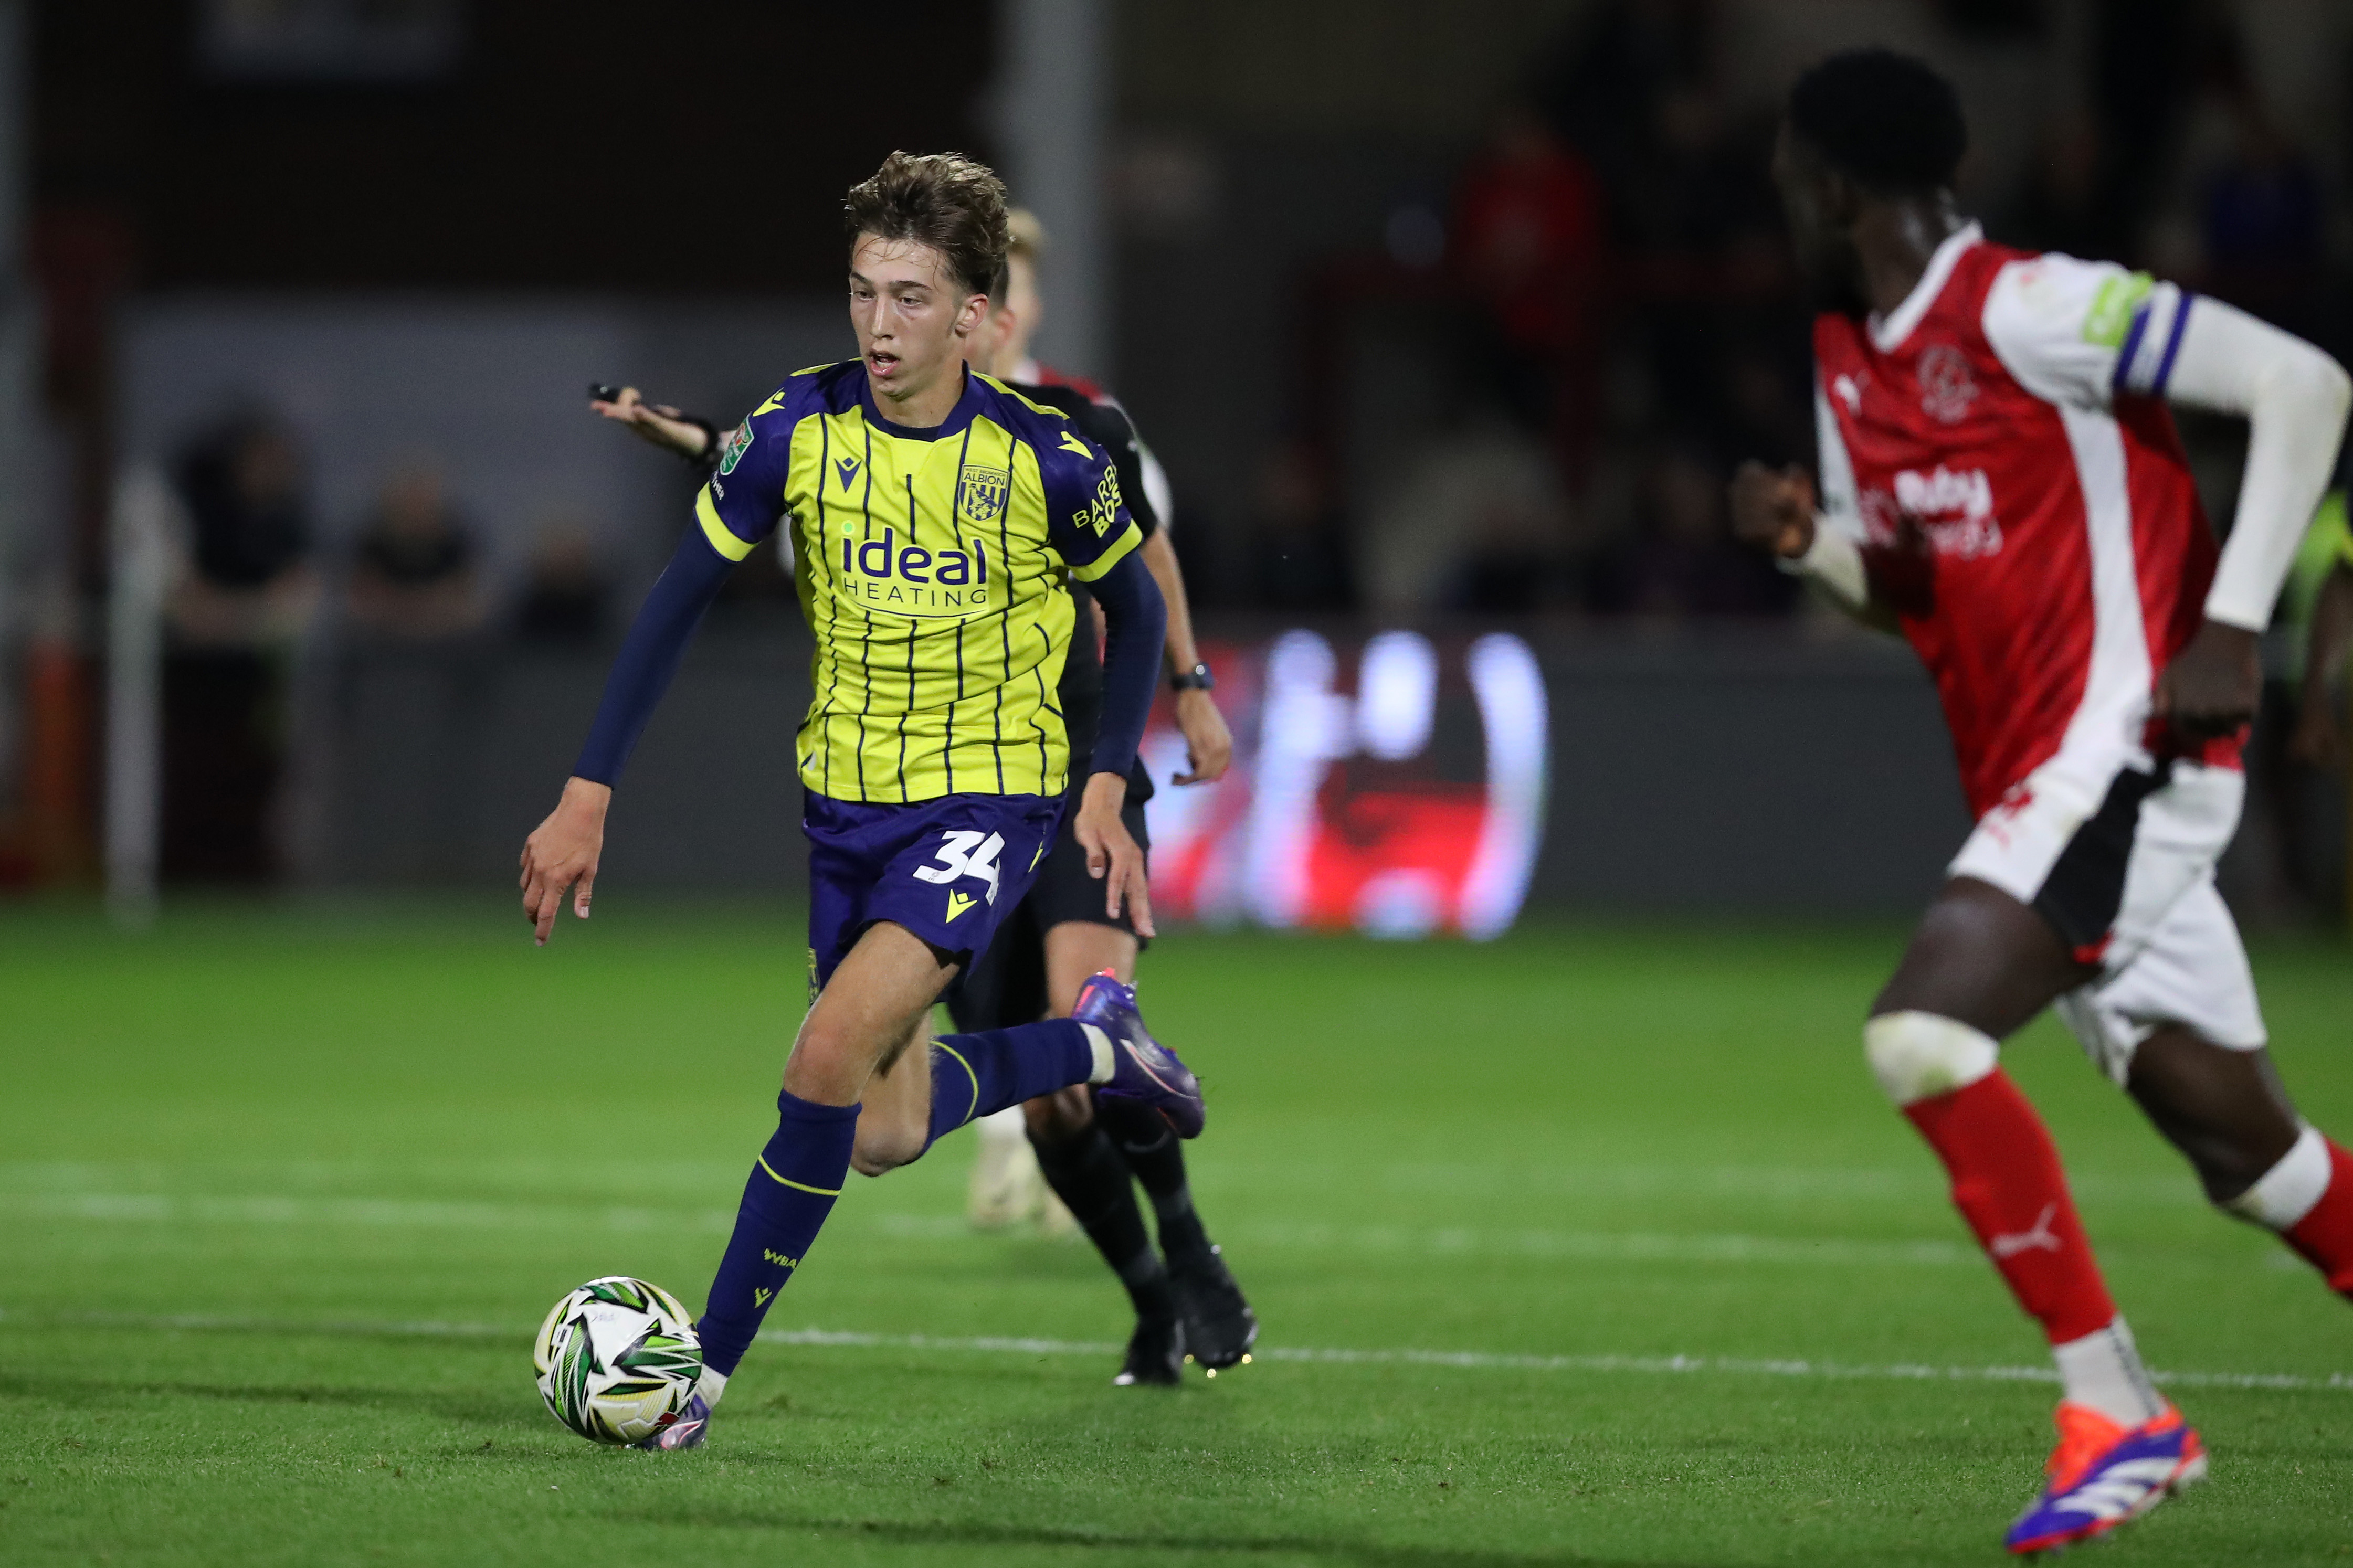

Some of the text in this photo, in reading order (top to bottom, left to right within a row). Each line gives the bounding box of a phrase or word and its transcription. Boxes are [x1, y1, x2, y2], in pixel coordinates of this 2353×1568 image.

[964, 473, 1005, 485] ALBION
[843, 522, 987, 585] ideal
[843, 577, 987, 607] HEATING
[912, 830, 1005, 906] 34
[764, 1248, 797, 1269] WBA
